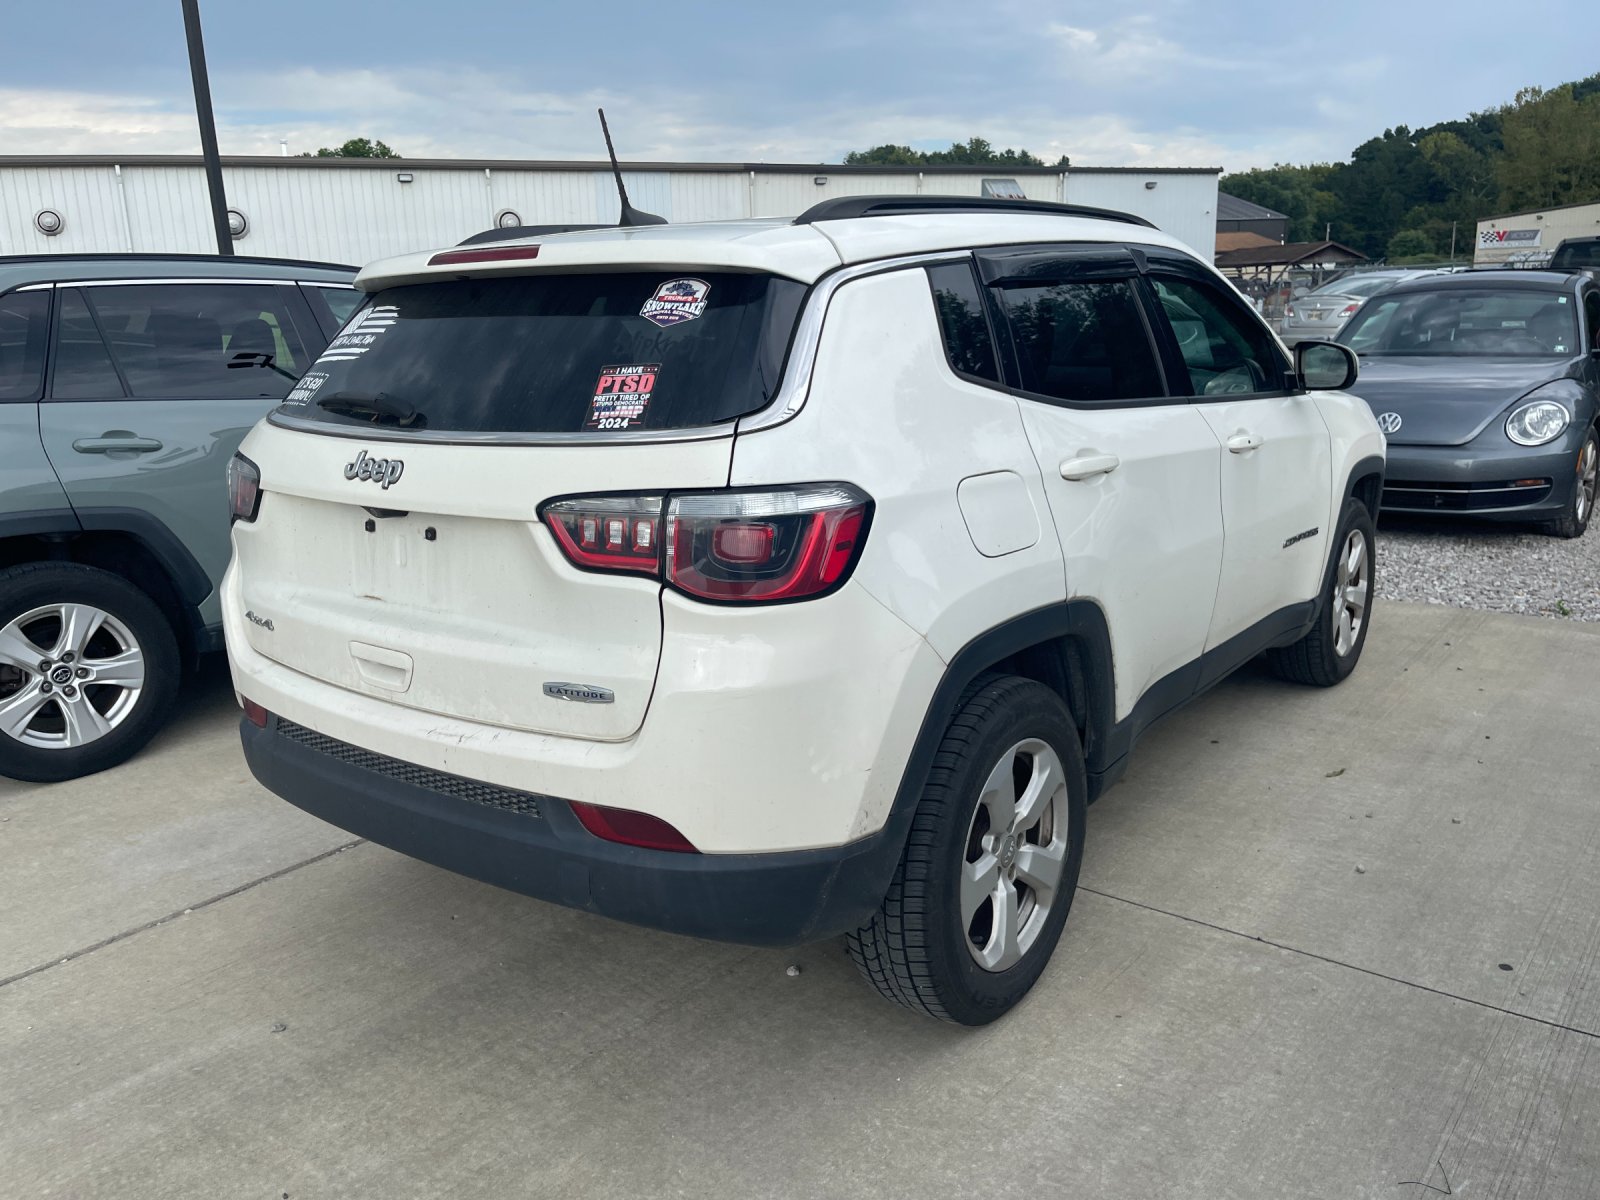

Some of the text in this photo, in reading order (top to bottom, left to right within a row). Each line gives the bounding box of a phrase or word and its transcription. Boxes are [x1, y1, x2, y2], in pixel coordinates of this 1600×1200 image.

[643, 300, 705, 316] SNOWFLAKE
[615, 366, 644, 375] I HAVE
[596, 374, 655, 395] PTSD
[592, 405, 644, 420] TRUMP
[597, 418, 630, 429] 2024
[344, 450, 404, 490] Jeep
[549, 686, 606, 699] LATITUDE
